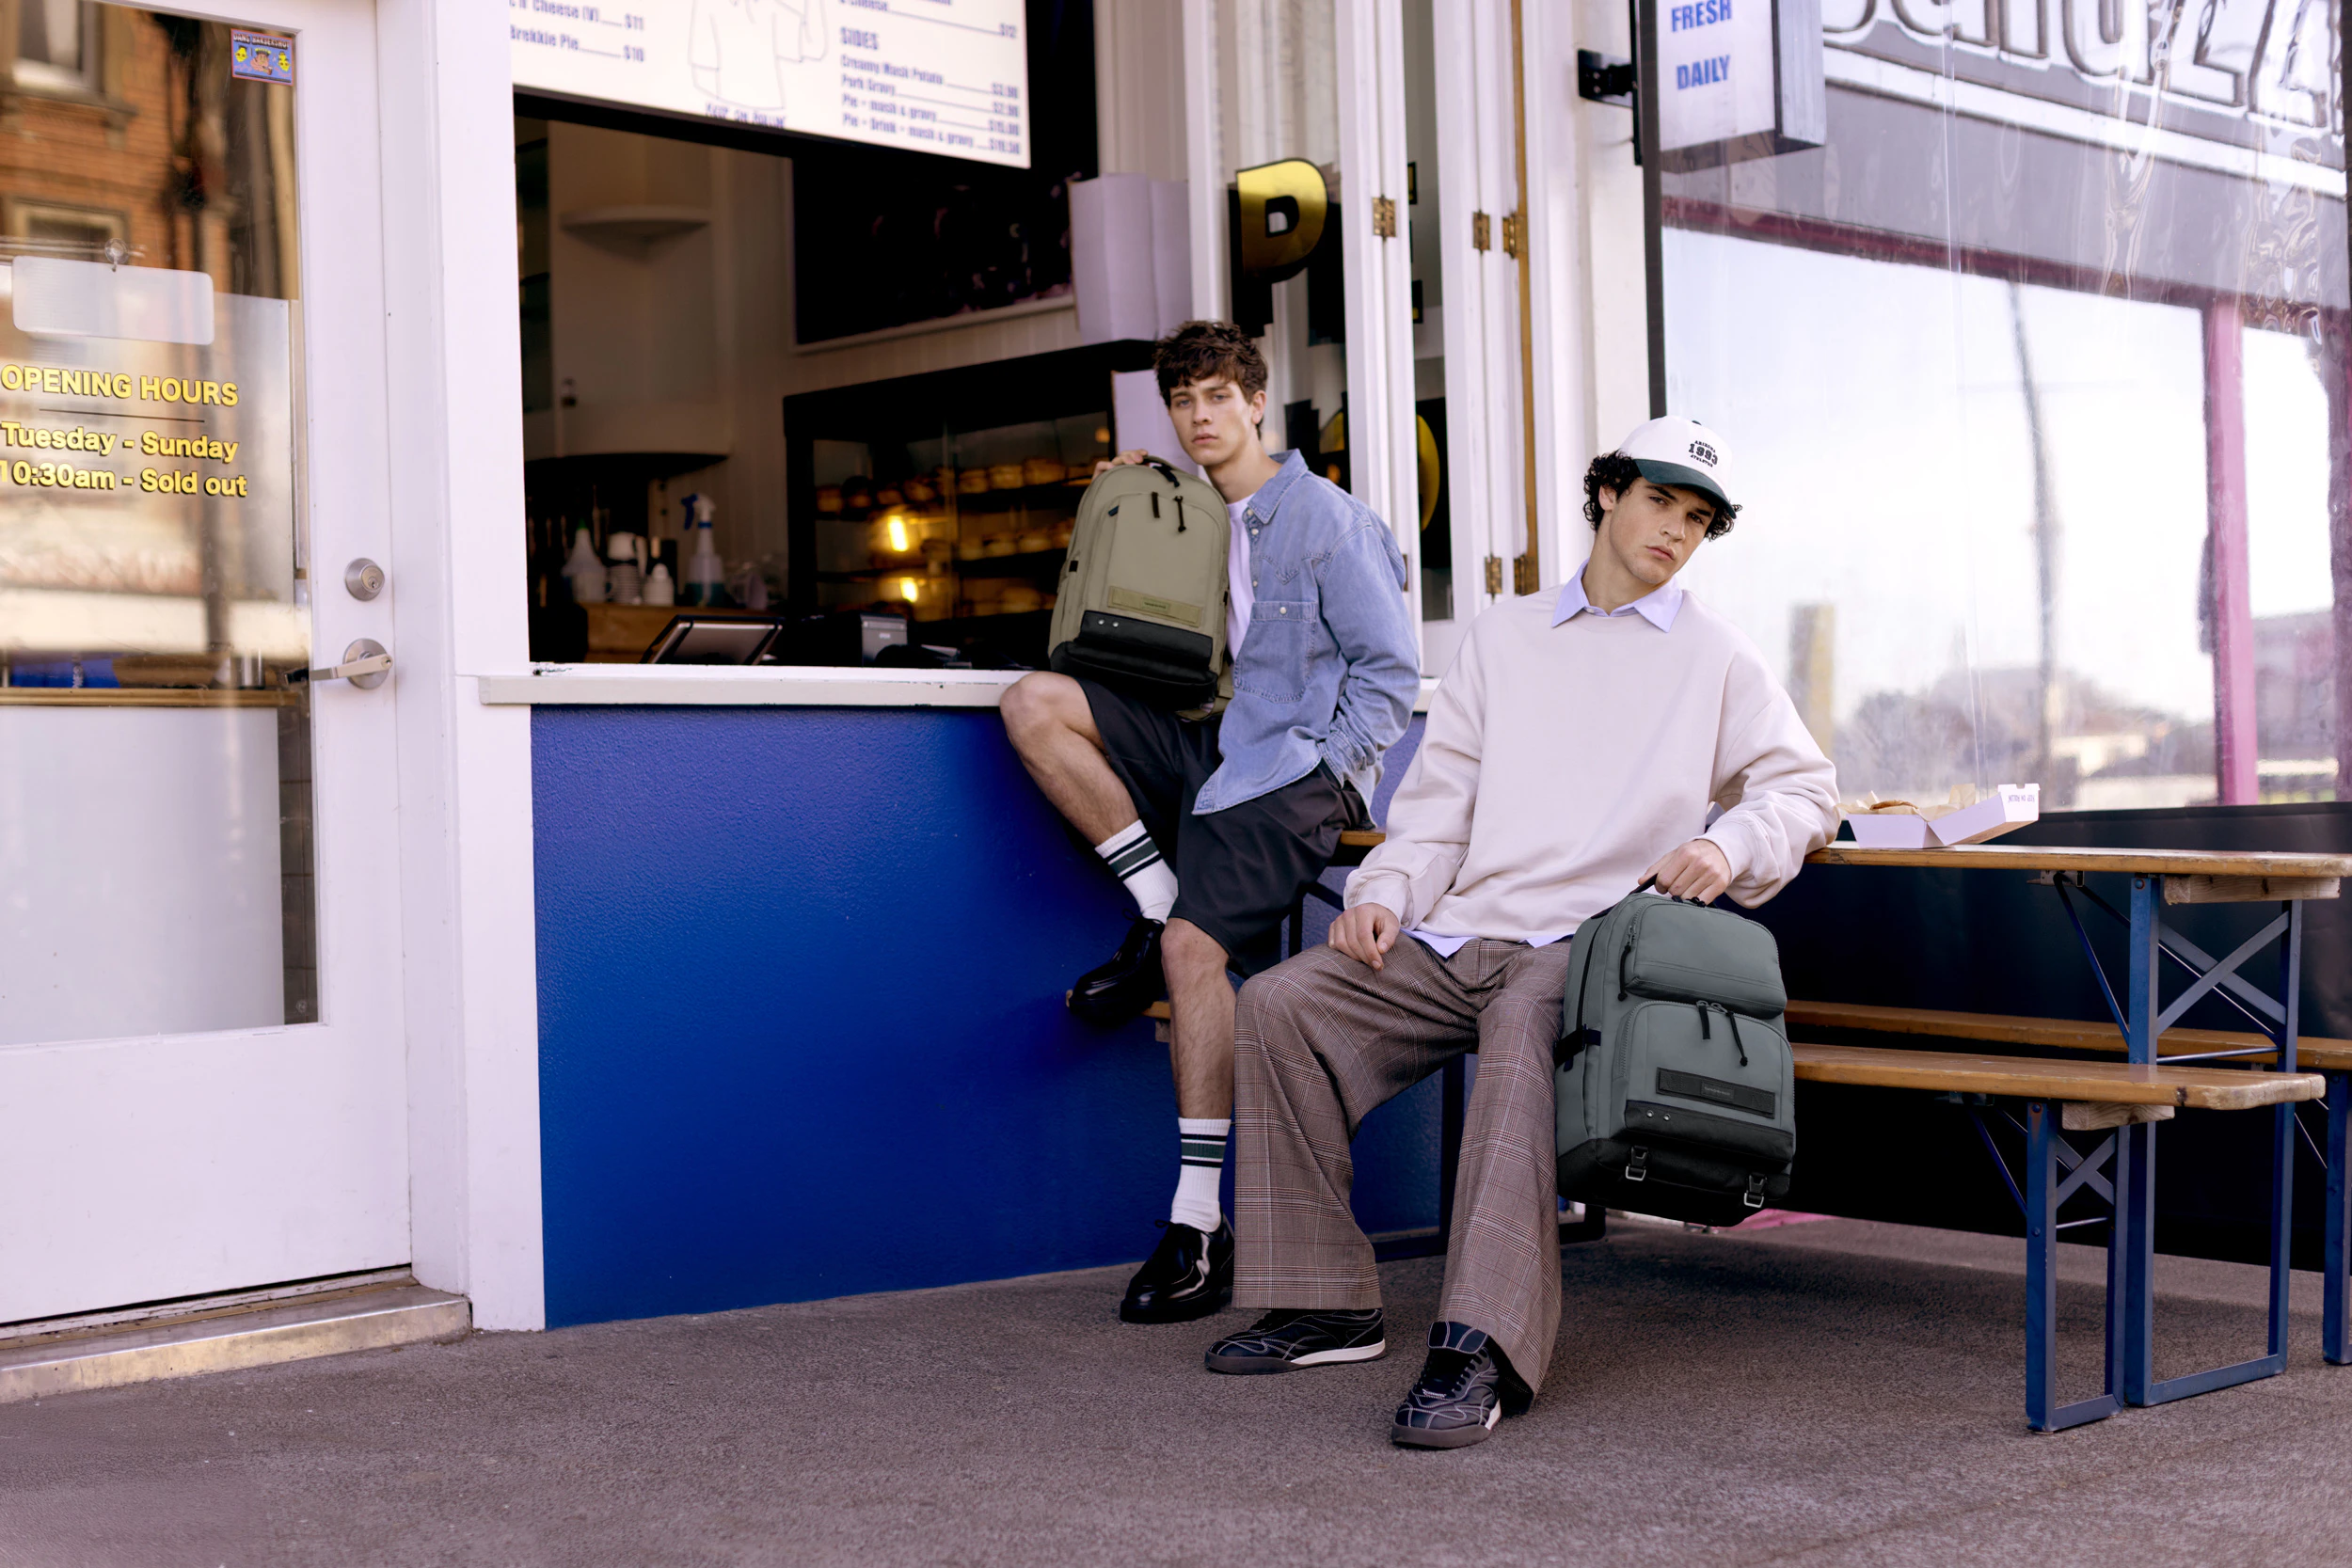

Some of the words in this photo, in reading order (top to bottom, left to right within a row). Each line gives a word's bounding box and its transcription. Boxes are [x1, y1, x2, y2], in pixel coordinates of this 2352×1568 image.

[1671, 0, 1732, 32] FRESH
[510, 24, 556, 46] Brekkie
[560, 34, 579, 51] Pie
[840, 26, 879, 50] SIDES
[841, 55, 880, 74] Creamy
[882, 62, 909, 79] Mash
[913, 68, 944, 85] Potato
[841, 73, 864, 89] Pork
[867, 79, 896, 96] Gravy
[1677, 55, 1730, 90] DAILY
[842, 93, 858, 108] Pie
[870, 100, 896, 115] mash
[910, 107, 937, 123] gravy
[843, 113, 859, 128] Pie
[871, 119, 896, 134] Drink
[909, 124, 934, 140] mash
[947, 133, 974, 149] gravy
[1, 364, 132, 399] OPENING
[140, 375, 239, 406] HOURS
[1, 421, 117, 456] Tuesday
[122, 439, 135, 449] -
[142, 430, 239, 464] Sunday
[1688, 443, 1718, 466] 1993
[0, 459, 116, 490] 10:30am
[121, 477, 135, 486] -
[140, 467, 198, 495] Sold
[204, 473, 247, 497] out
